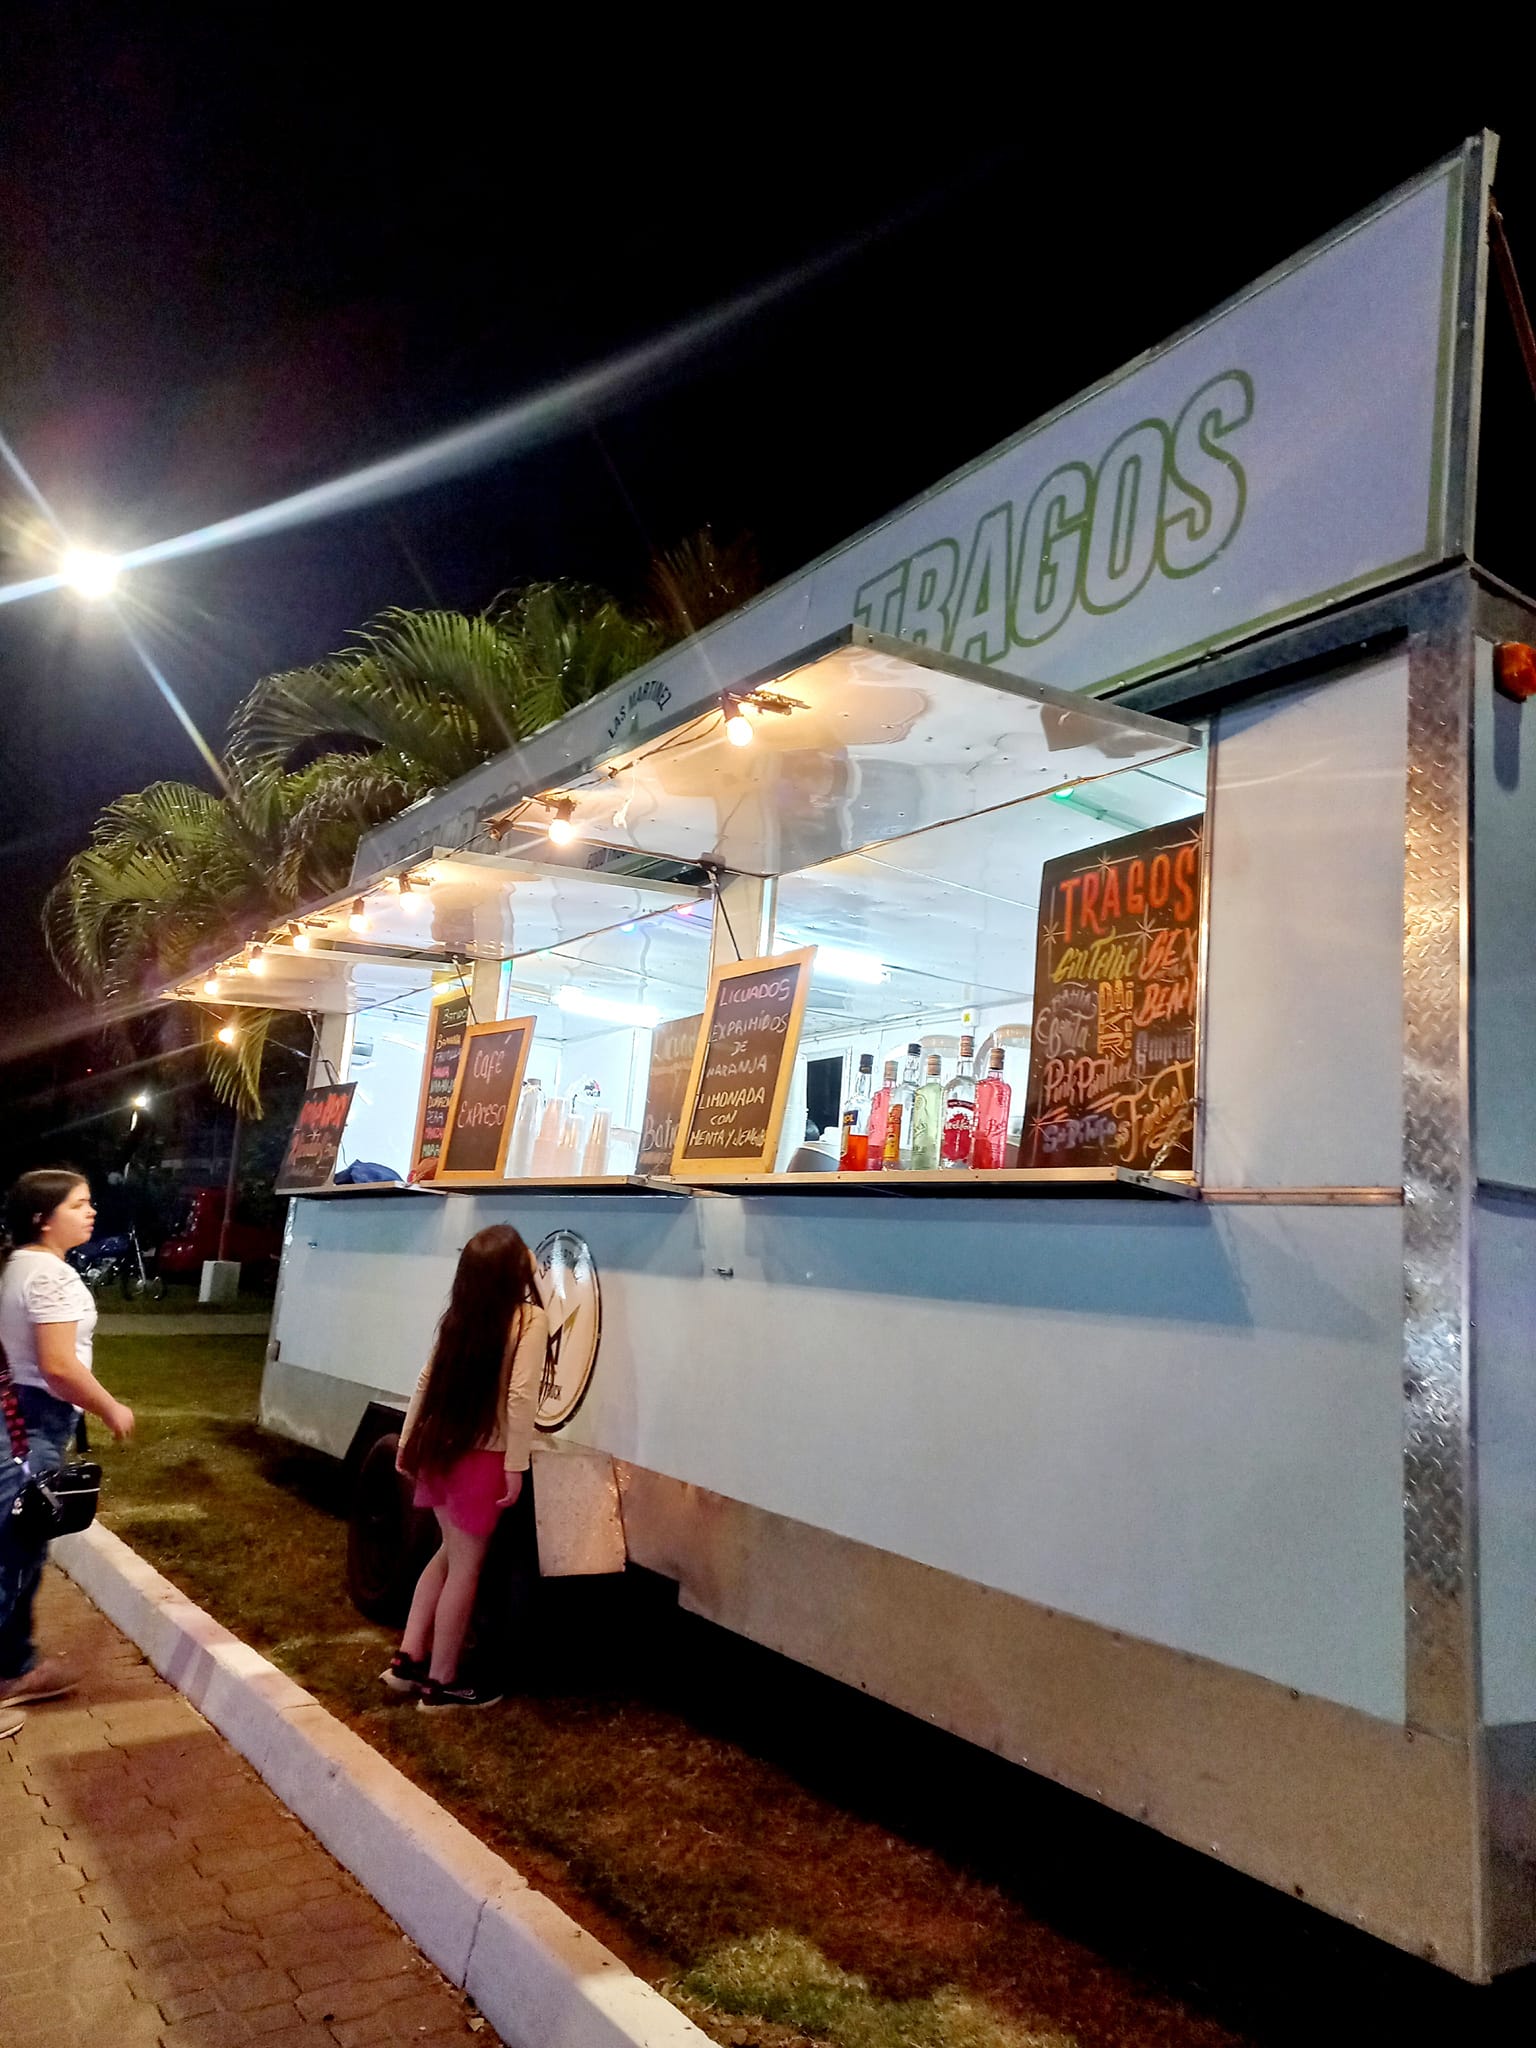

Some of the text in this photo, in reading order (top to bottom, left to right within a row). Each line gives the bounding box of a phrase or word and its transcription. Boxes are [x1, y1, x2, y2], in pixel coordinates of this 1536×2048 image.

[854, 369, 1254, 665] TRAGOS
[608, 705, 626, 739] LAS
[1059, 847, 1197, 943] TRAGOS
[719, 979, 790, 1006] LICUADOS
[706, 1055, 767, 1078] NARANJA
[698, 1087, 766, 1109] LIMONADA
[710, 1110, 737, 1125] CON
